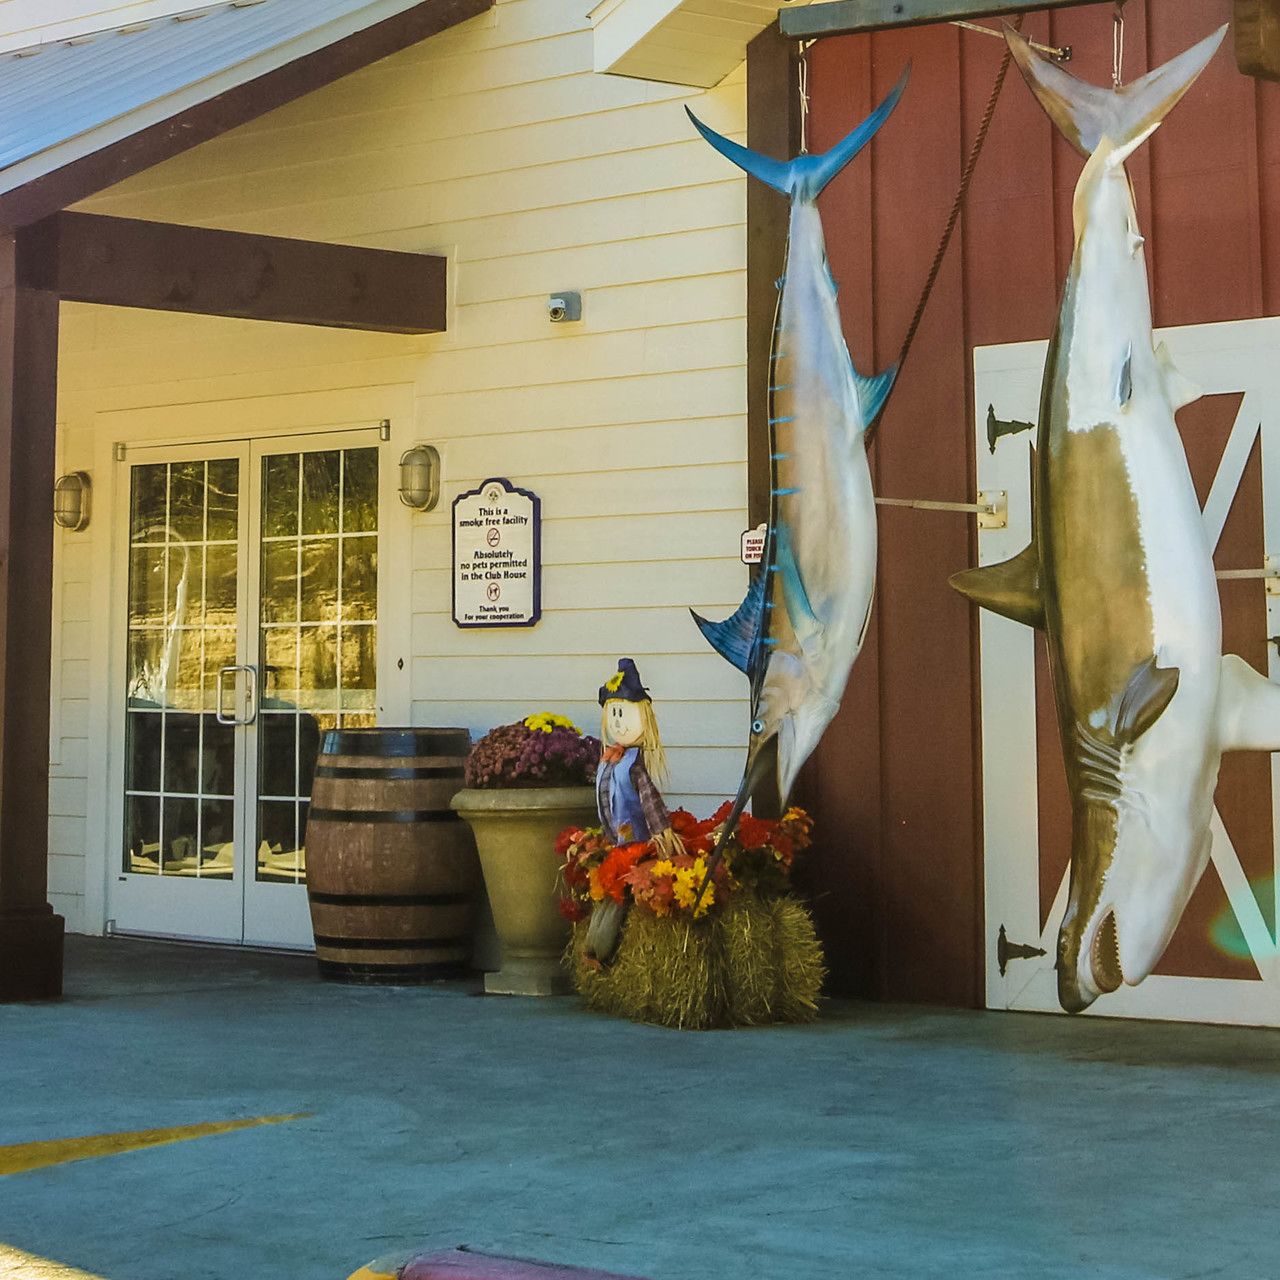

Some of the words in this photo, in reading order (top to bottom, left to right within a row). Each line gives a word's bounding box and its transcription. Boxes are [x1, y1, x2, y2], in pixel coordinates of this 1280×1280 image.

[478, 507, 494, 516] This
[459, 518, 483, 528] smoke
[485, 517, 501, 526] free
[502, 515, 528, 525] facility
[474, 550, 513, 559] Absolutely
[460, 562, 470, 570] no
[472, 561, 488, 570] pets
[489, 558, 528, 569] permitted
[461, 572, 469, 580] in
[470, 571, 483, 580] the
[484, 570, 502, 579] Club
[503, 570, 527, 579] House
[479, 605, 498, 613] Thank
